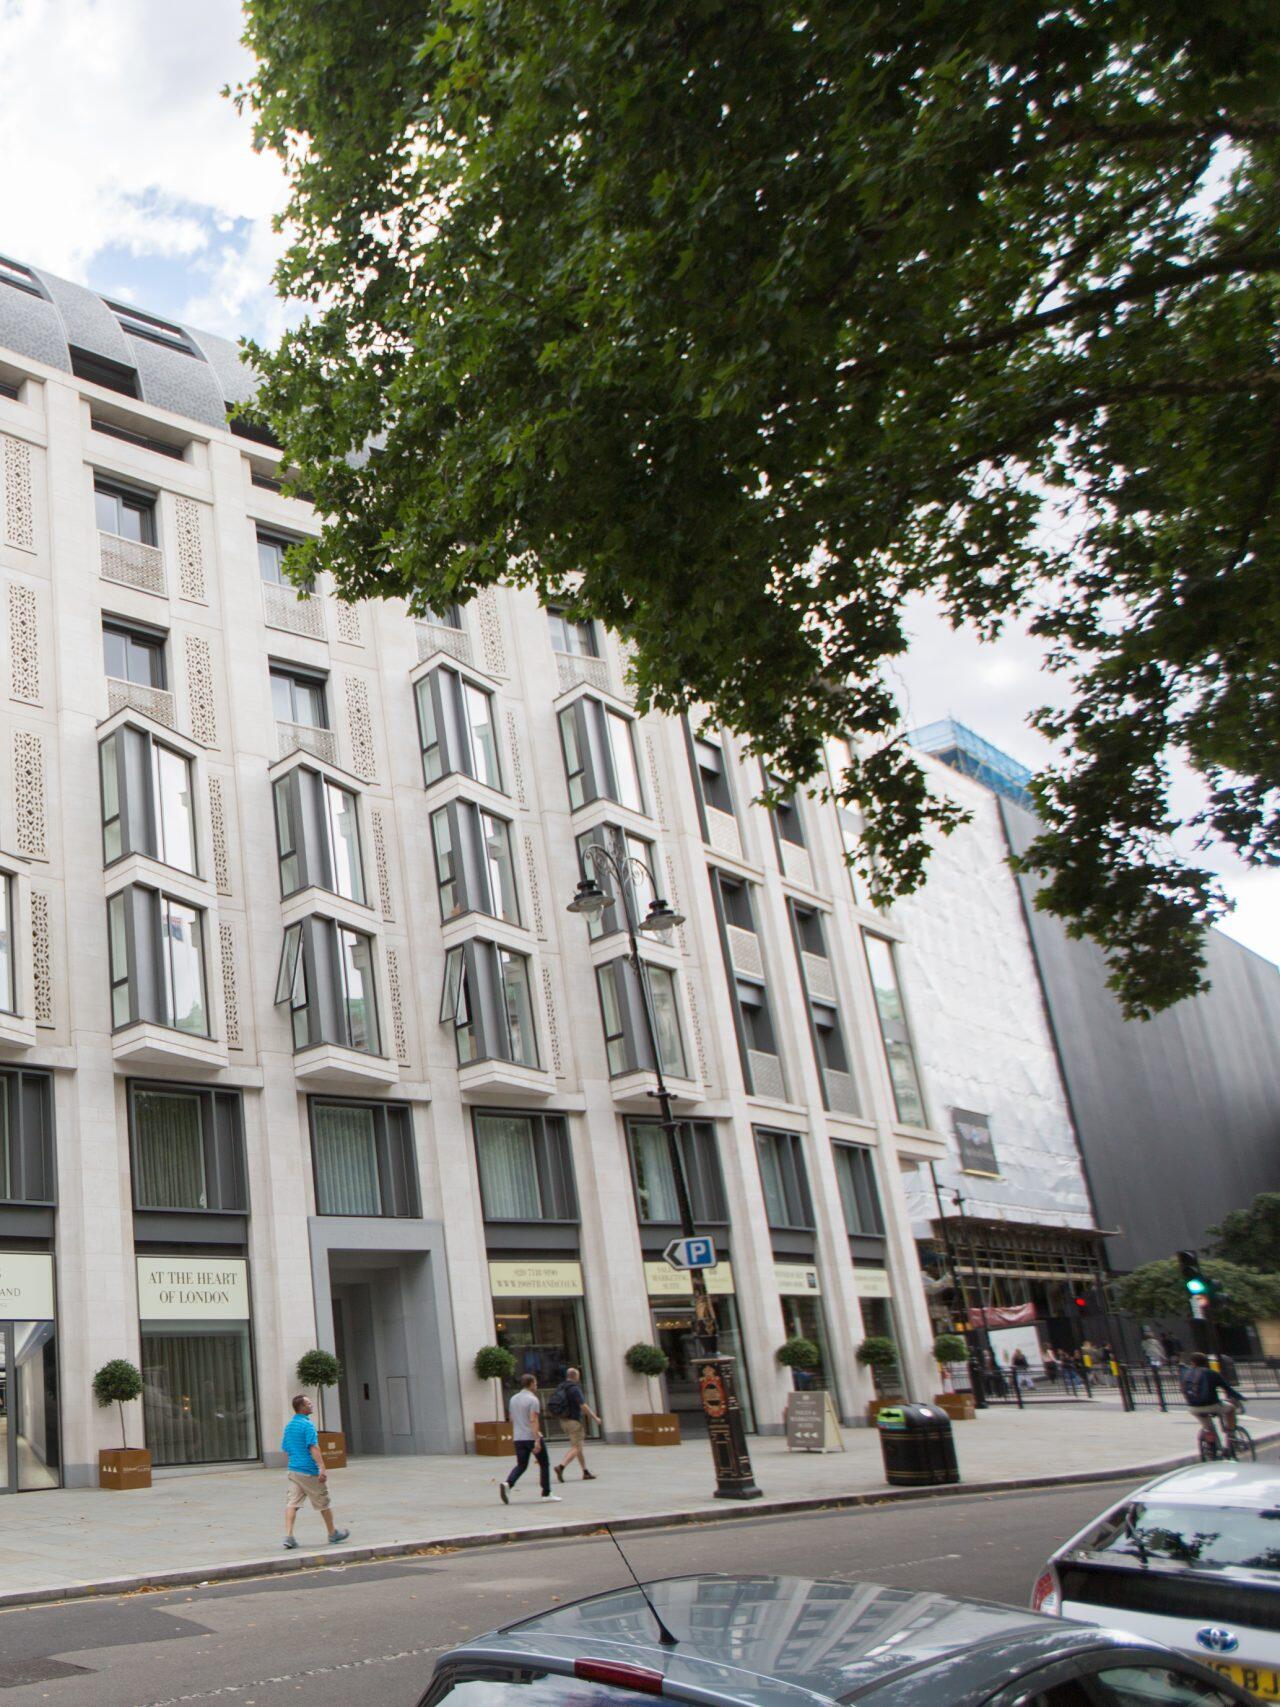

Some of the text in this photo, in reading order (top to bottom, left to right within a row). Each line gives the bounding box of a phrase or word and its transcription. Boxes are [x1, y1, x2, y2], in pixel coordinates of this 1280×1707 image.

[690, 1242, 706, 1263] P
[148, 1271, 238, 1286] AT THE HEART
[159, 1290, 231, 1304] OF LONDON
